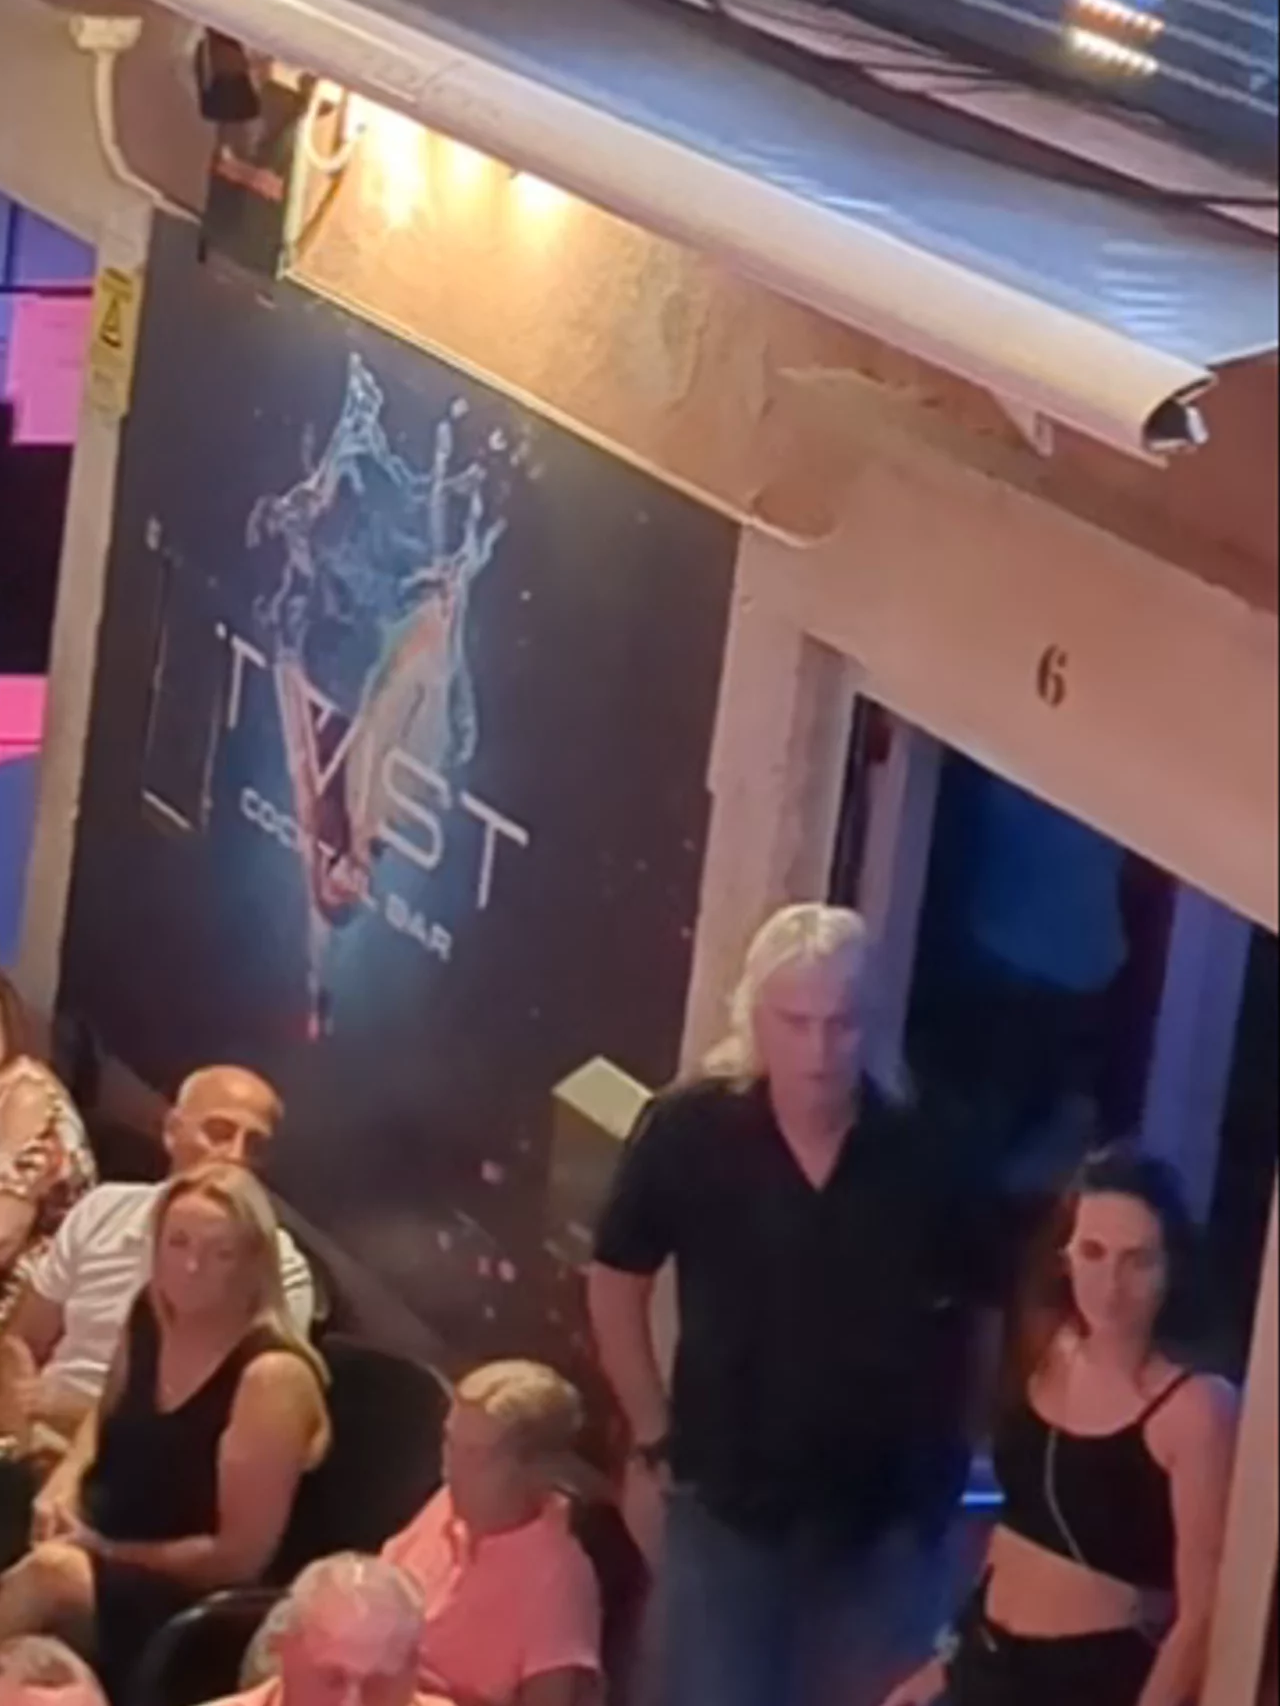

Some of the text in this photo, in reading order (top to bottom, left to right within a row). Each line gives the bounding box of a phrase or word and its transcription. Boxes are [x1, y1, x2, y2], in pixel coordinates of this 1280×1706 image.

[1036, 644, 1068, 708] 6
[241, 786, 453, 964] COCTAIL BAR
